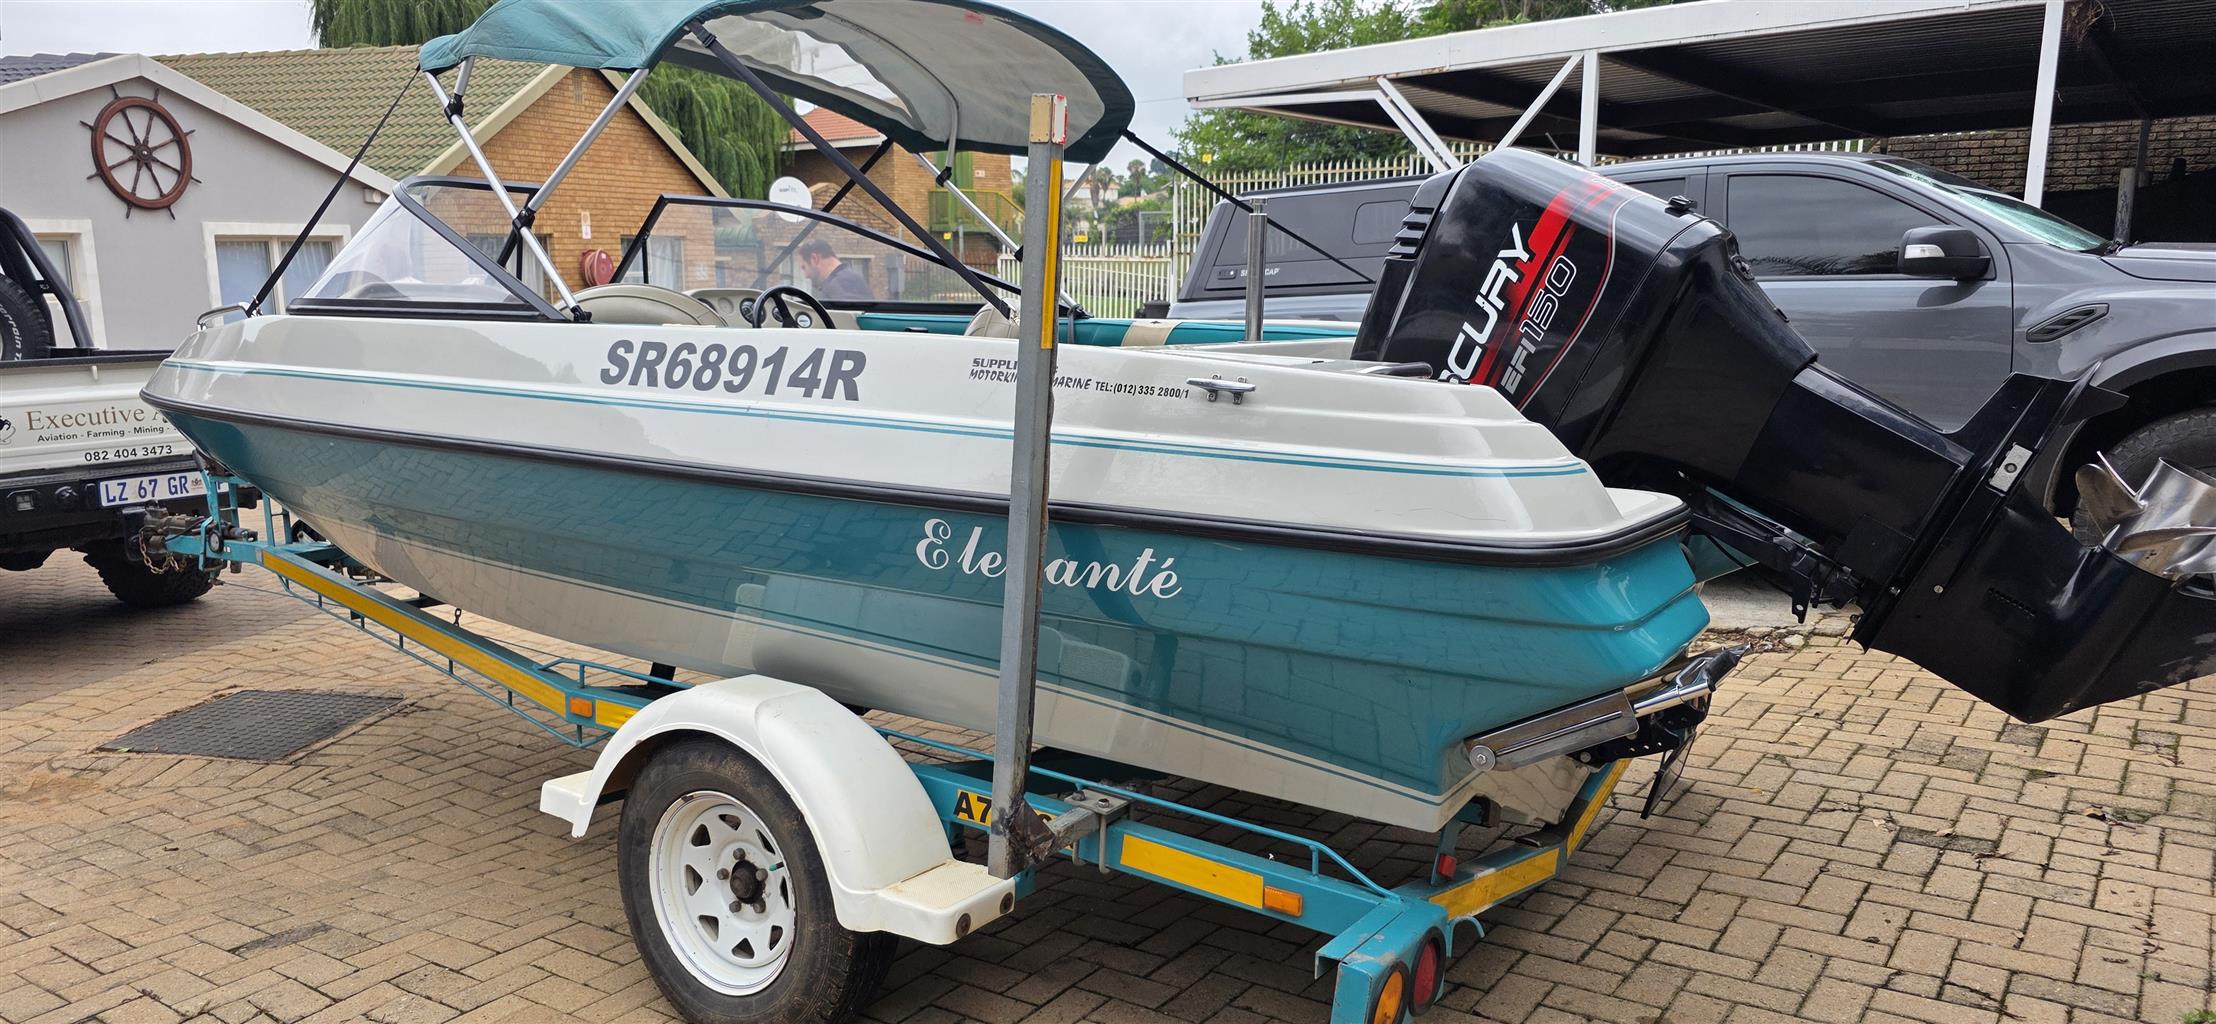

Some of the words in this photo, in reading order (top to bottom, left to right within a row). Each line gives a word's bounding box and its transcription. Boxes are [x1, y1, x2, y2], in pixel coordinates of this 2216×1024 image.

[1439, 221, 1530, 380] CURY
[0, 304, 22, 349] errain
[1500, 337, 1536, 395] EFI
[1518, 255, 1577, 342] 150
[600, 339, 867, 402] SR68914R
[972, 357, 1018, 370] SUPPLI
[969, 368, 1017, 384] MOTORKI
[1157, 387, 1190, 400] 2800/1
[25, 406, 145, 431] Executive
[37, 432, 78, 443] Aviation
[87, 429, 125, 438] Farming
[133, 425, 164, 434] Mining
[84, 450, 110, 462] 082
[114, 448, 138, 459] 404
[142, 445, 173, 457] 3473
[105, 481, 129, 503] LZ
[138, 478, 158, 499] 67
[167, 475, 190, 496] GR
[915, 518, 1183, 599] Eleanté
